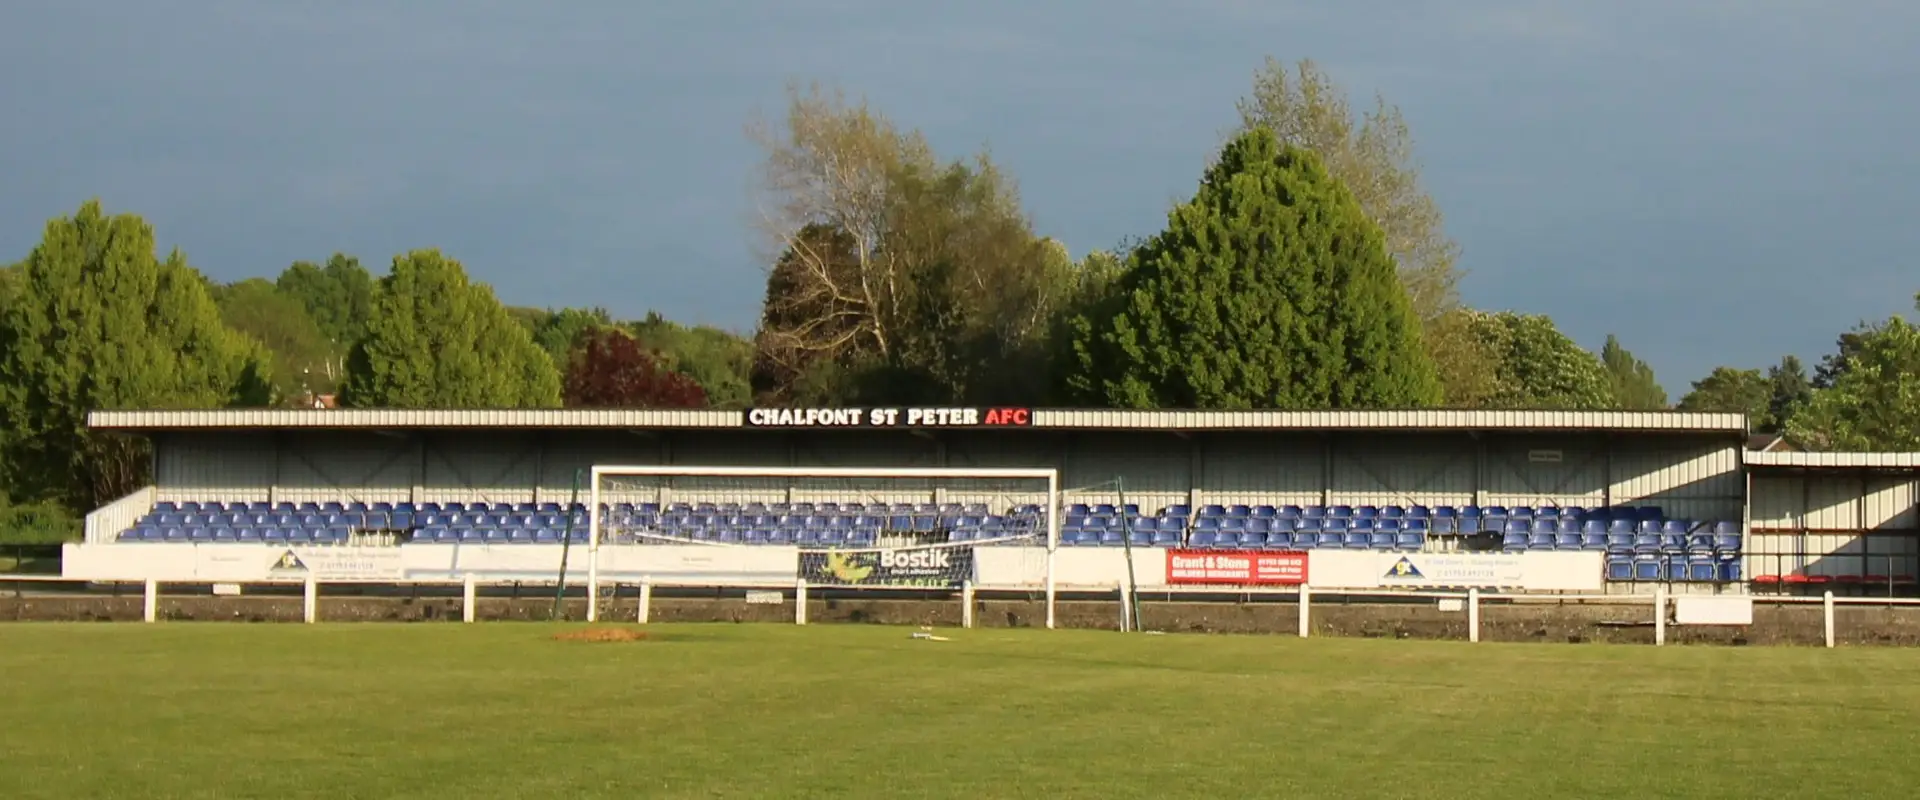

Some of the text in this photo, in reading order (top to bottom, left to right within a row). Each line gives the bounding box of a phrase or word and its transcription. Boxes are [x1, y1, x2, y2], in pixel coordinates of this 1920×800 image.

[749, 408, 1028, 426] CHALFONT ST PETER AFC
[881, 548, 949, 568] Bostik
[1172, 556, 1250, 569] Grant & Stone
